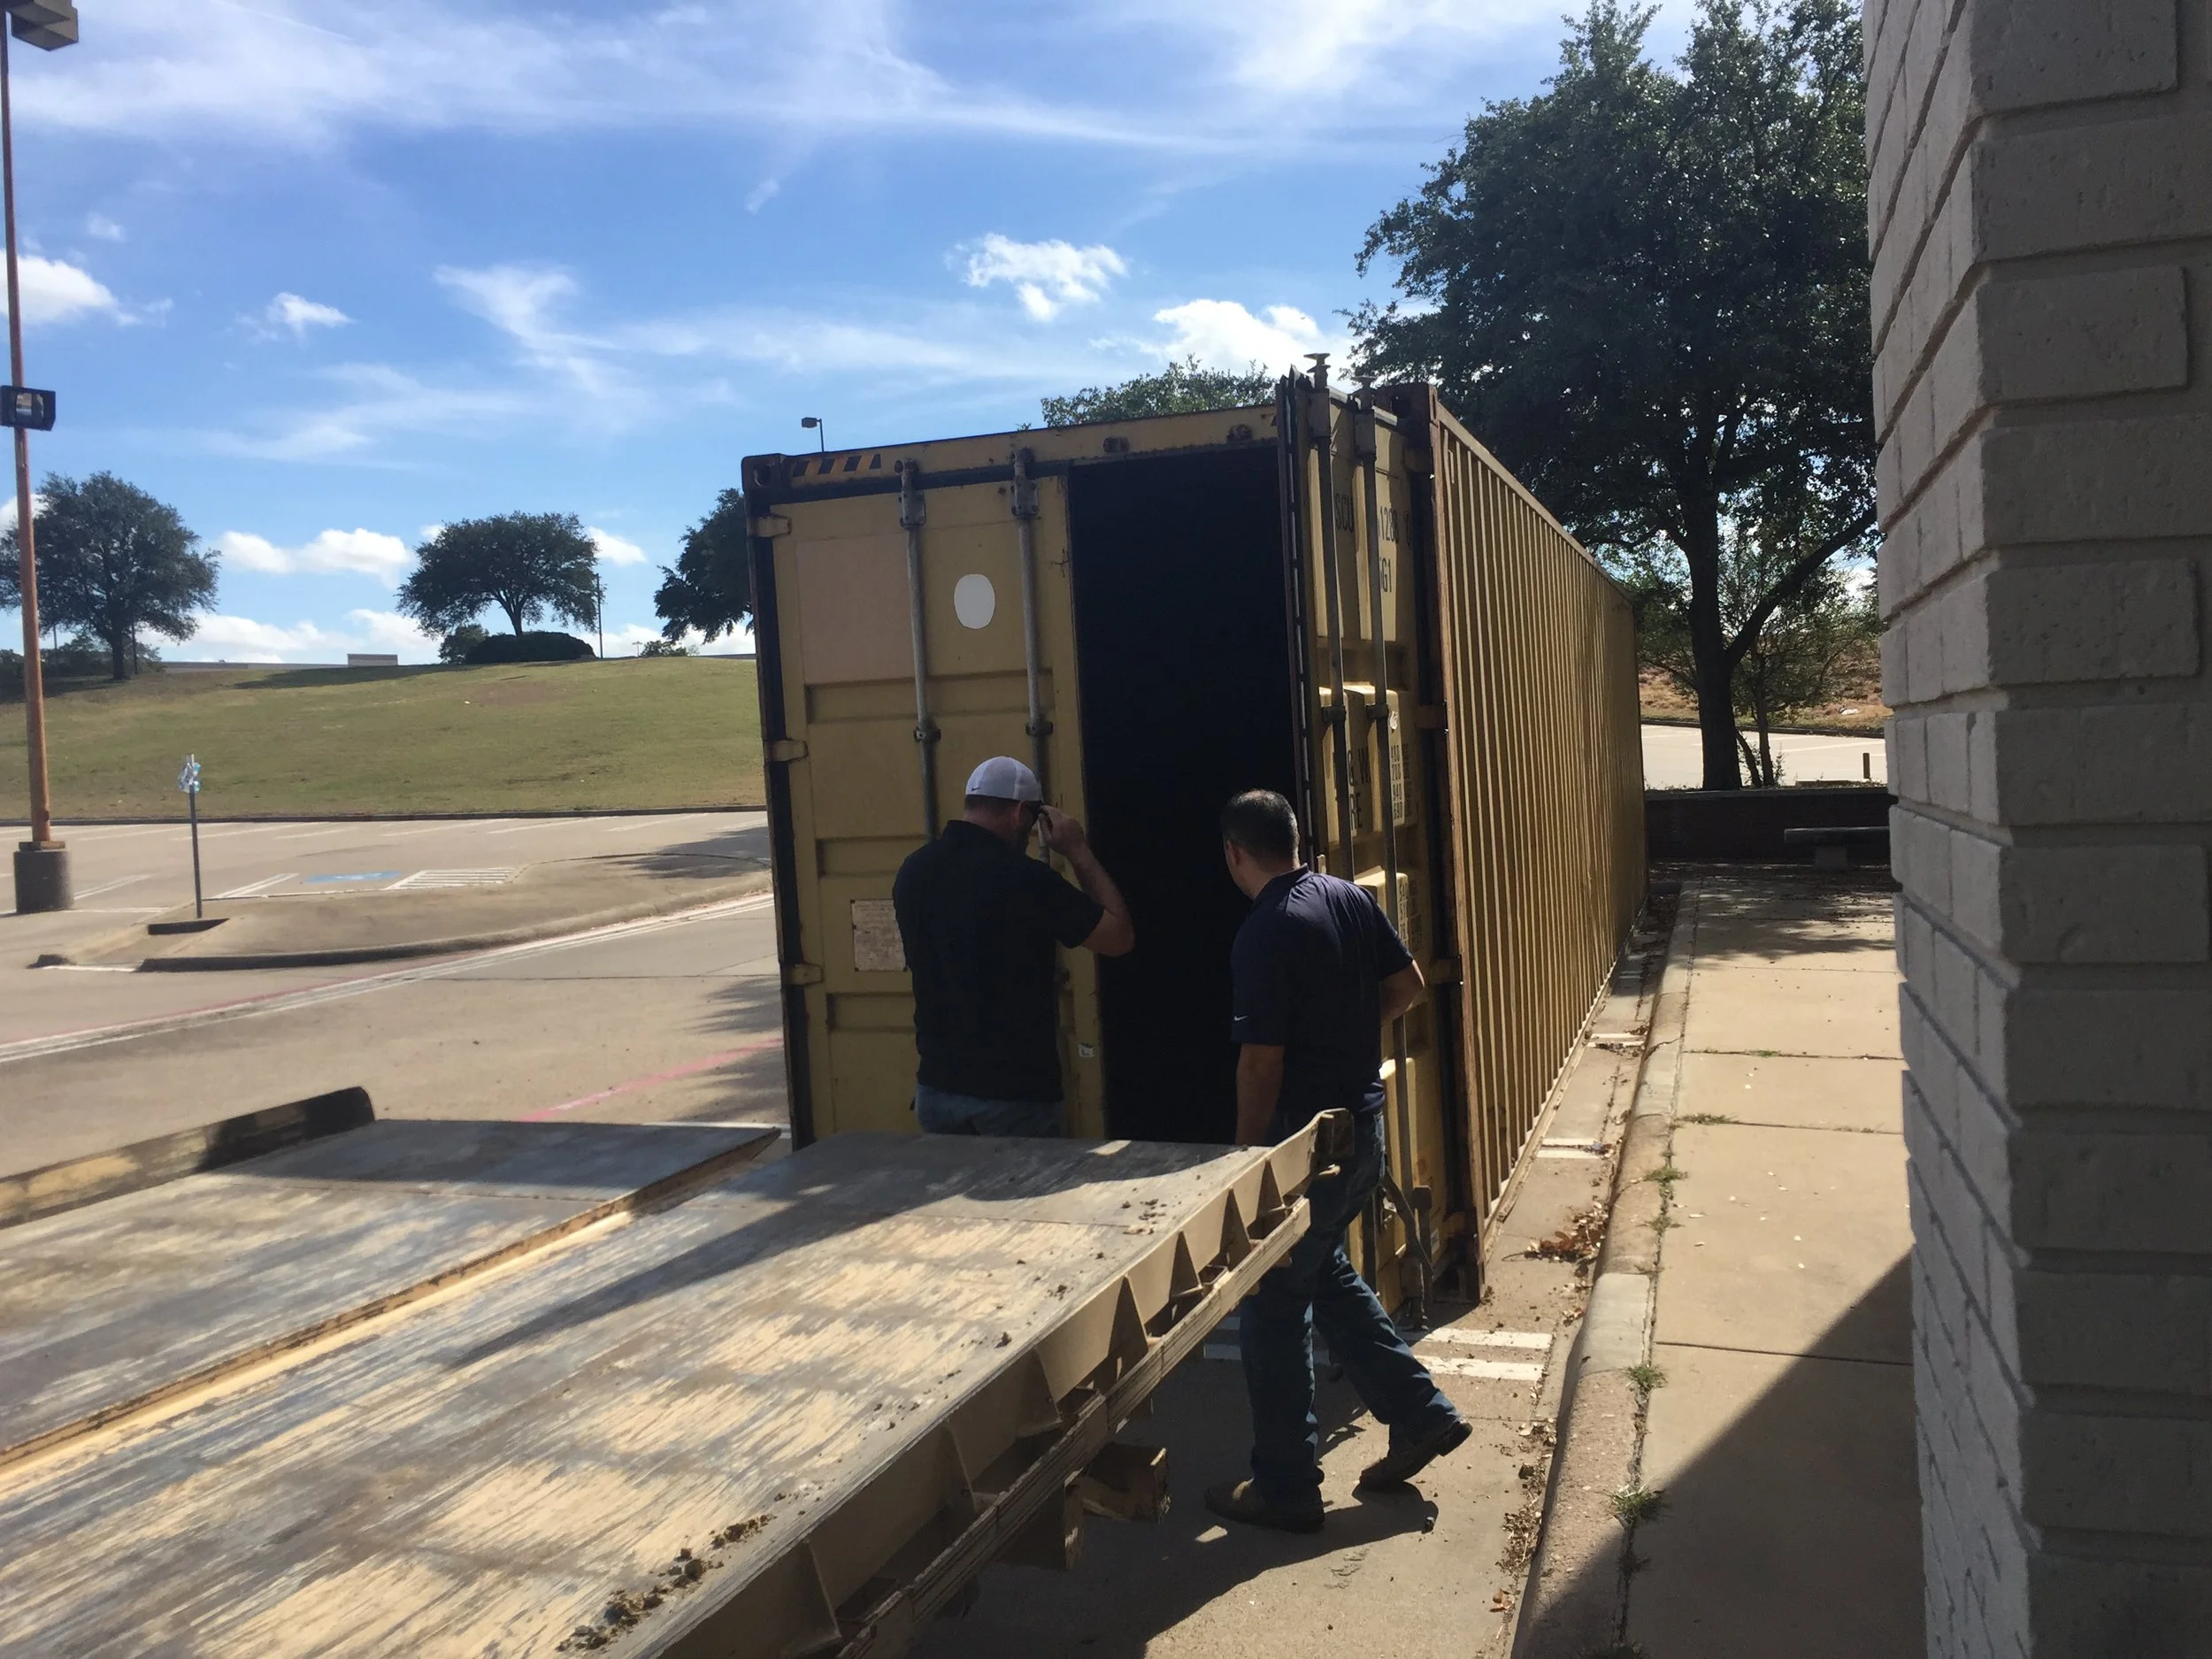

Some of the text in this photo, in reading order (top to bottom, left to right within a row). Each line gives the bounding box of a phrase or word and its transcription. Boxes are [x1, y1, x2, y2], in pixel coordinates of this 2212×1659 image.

[1334, 493, 1354, 533] SCU
[1378, 505, 1400, 544] 1288
[1380, 557, 1393, 593] G1
[1349, 792, 1363, 830] RE
